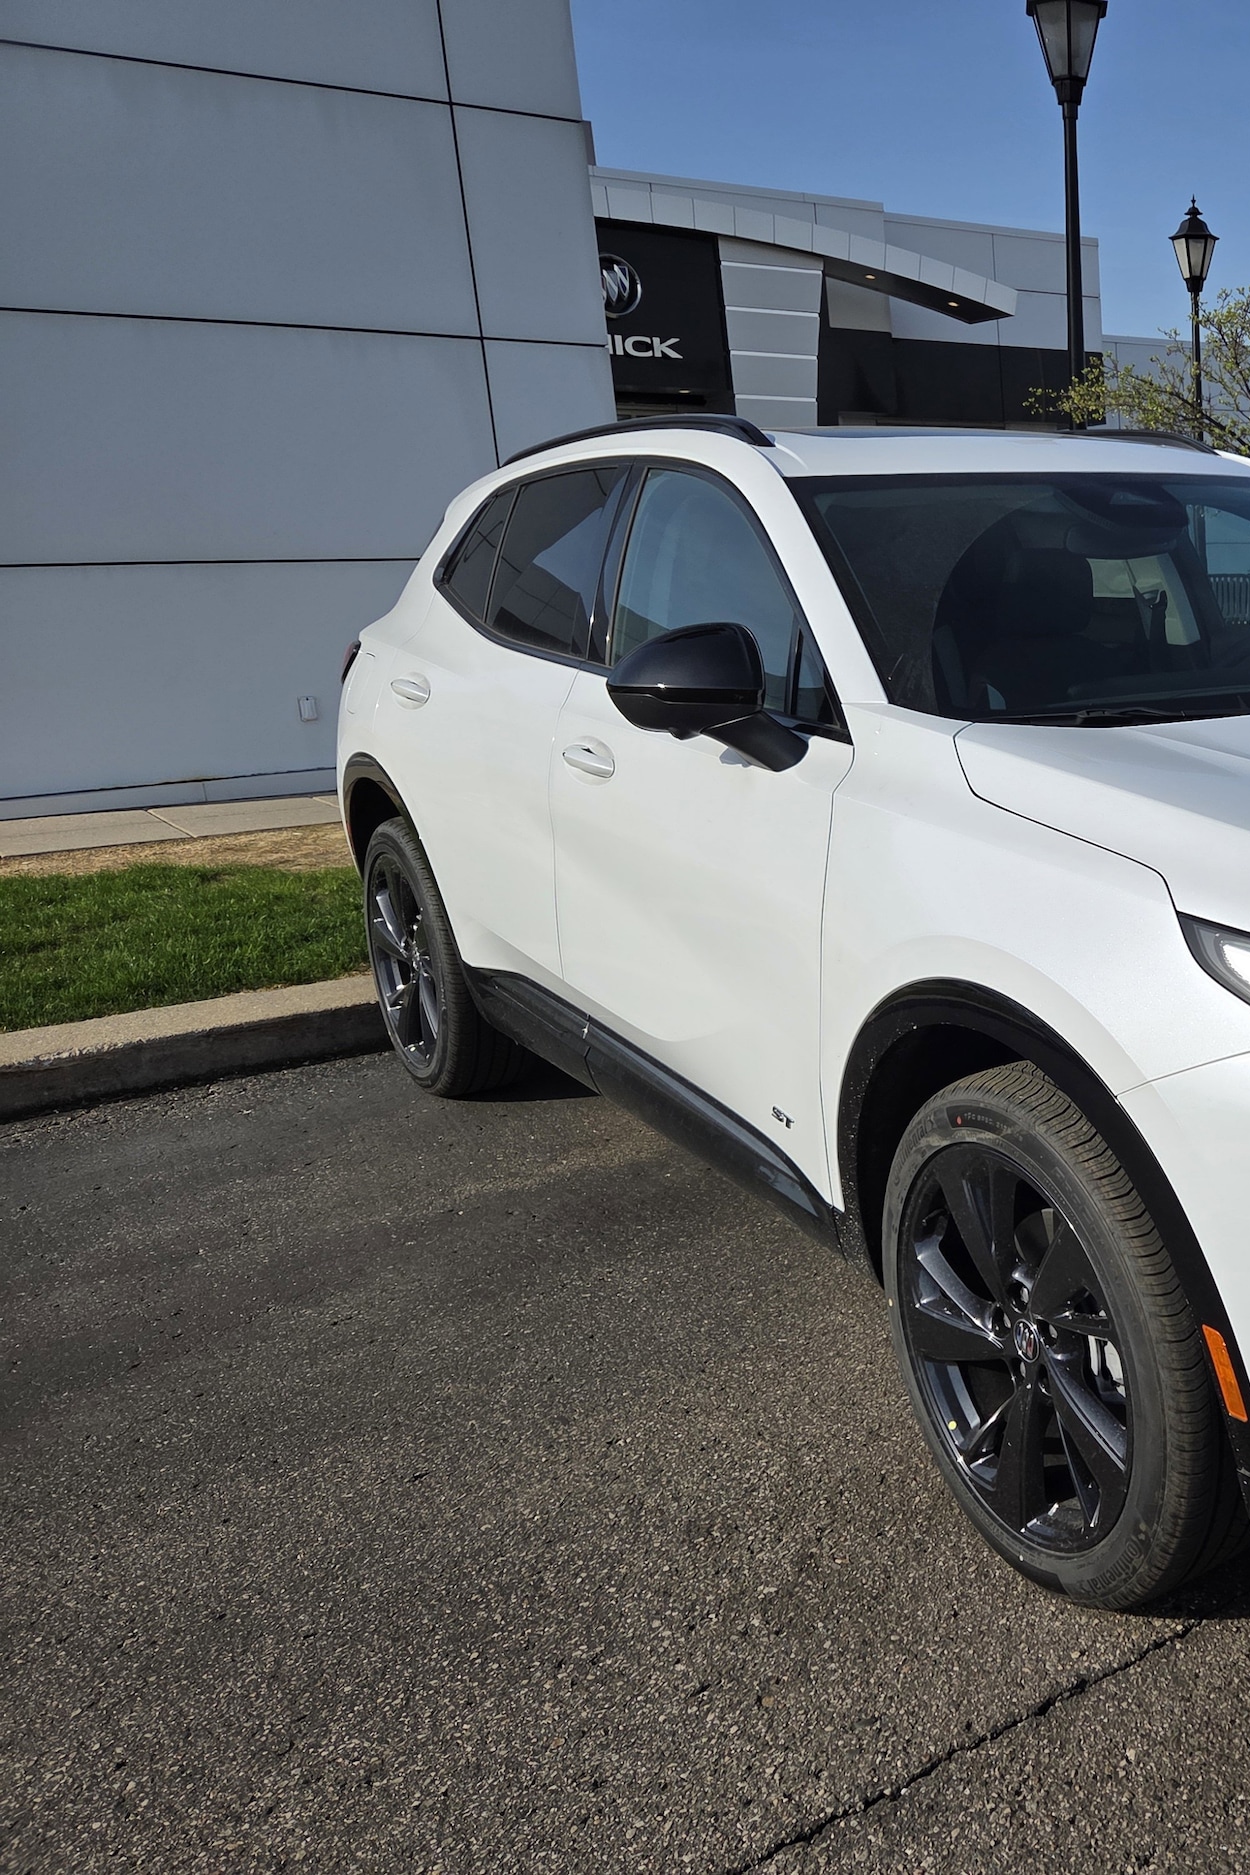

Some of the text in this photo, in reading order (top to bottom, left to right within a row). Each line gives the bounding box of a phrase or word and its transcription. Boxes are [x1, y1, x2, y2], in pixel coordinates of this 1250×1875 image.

[606, 333, 684, 359] ICK
[771, 1105, 795, 1129] ST
[1087, 1535, 1145, 1594] Continental
